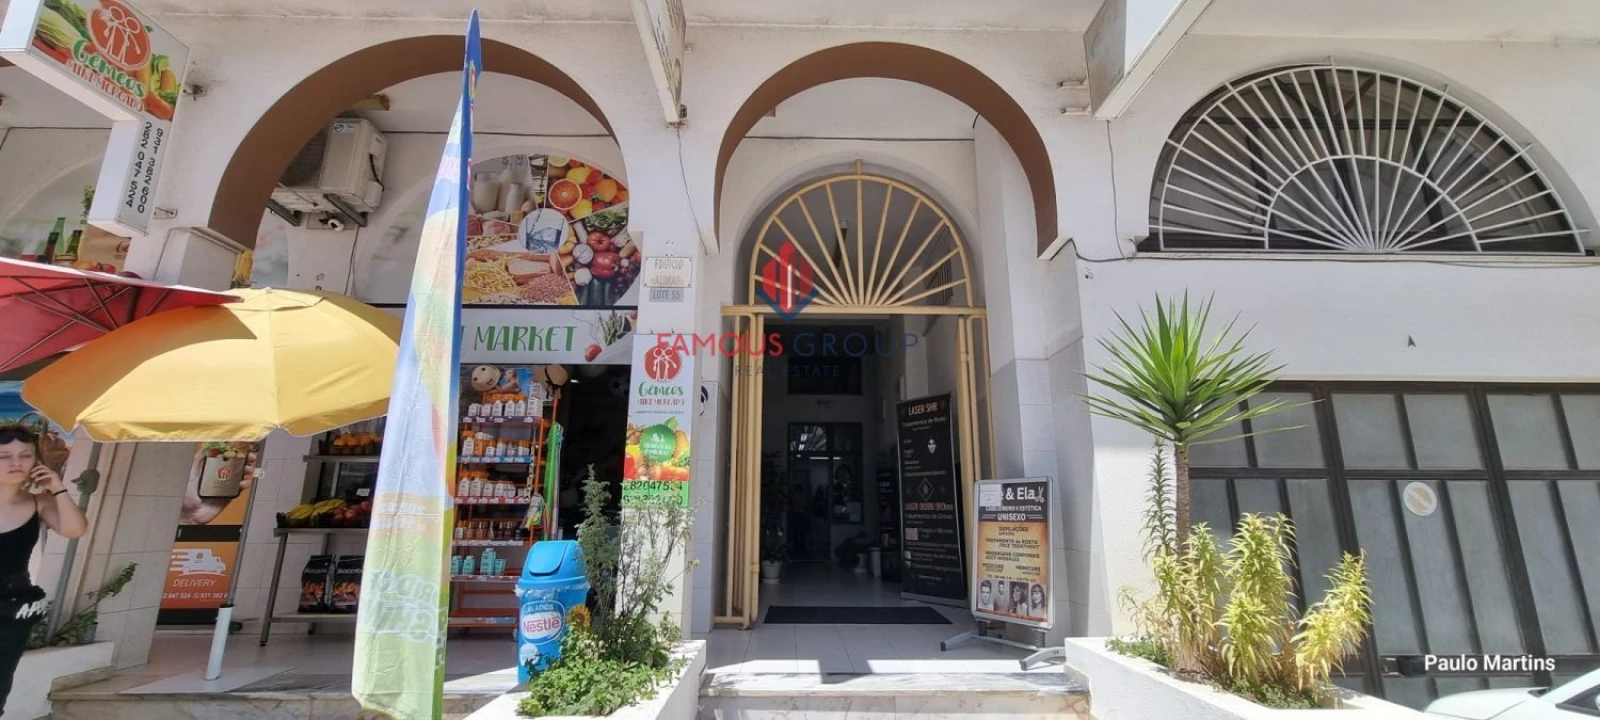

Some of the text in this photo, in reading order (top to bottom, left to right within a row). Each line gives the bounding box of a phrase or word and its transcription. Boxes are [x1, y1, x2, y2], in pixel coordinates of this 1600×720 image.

[126, 121, 153, 208] 282 047 524
[137, 127, 164, 213] 931 382 600
[652, 289, 669, 300] LOTE
[474, 325, 578, 352] MARKET
[908, 404, 925, 416] LASER
[1005, 487, 1014, 500] &
[1016, 486, 1035, 500] Ela
[997, 512, 1026, 522] UNISEXO
[172, 578, 218, 588] DELIVERY
